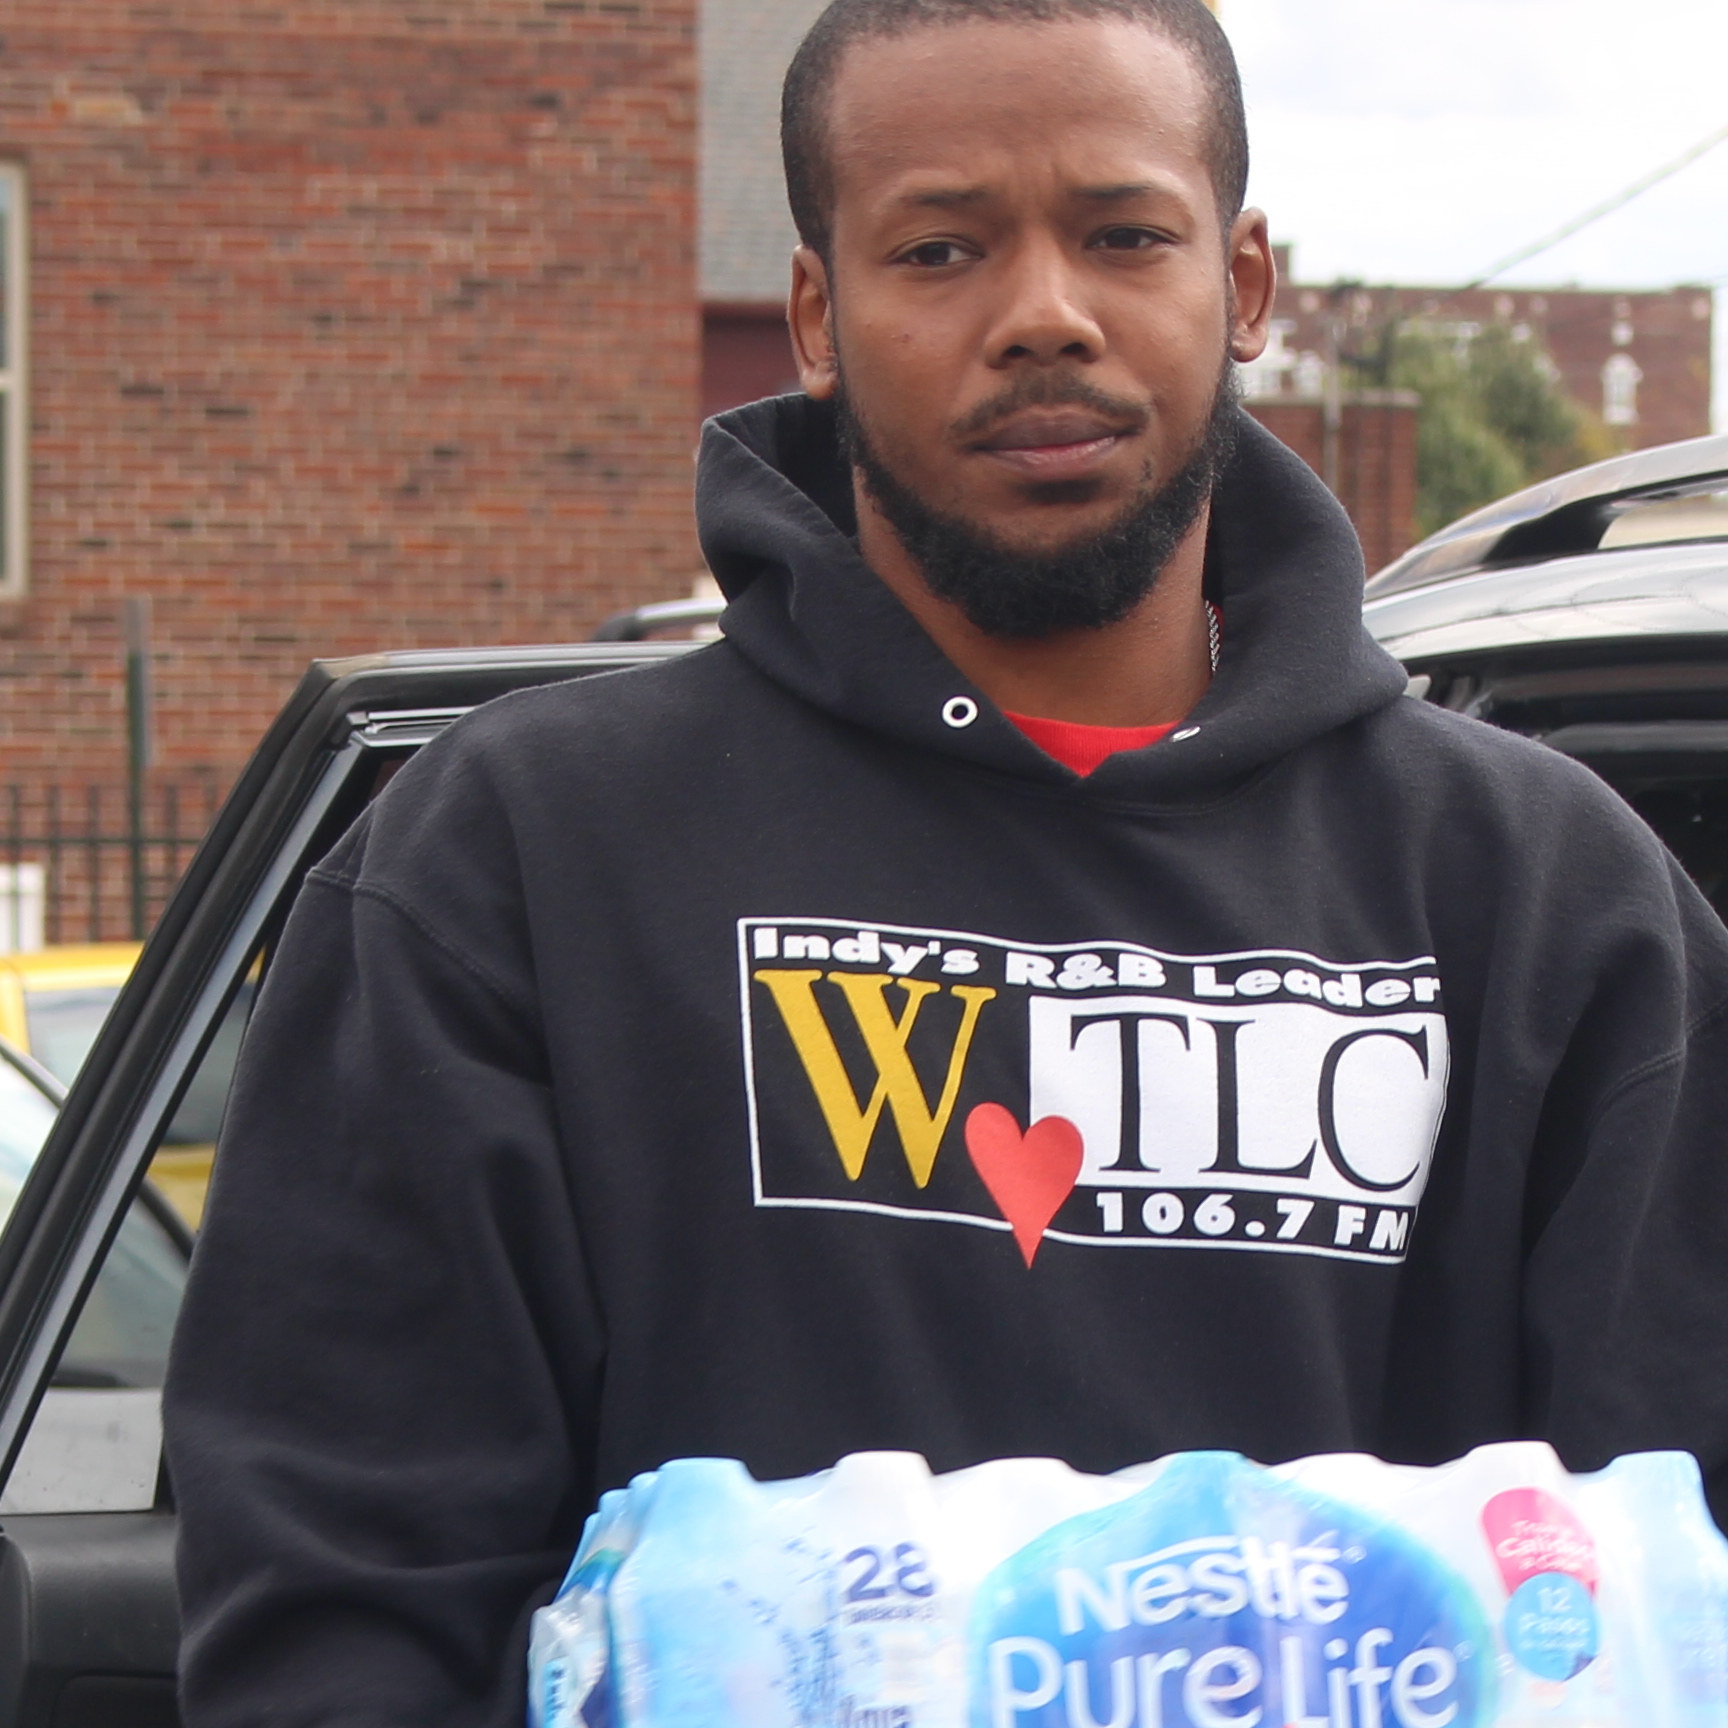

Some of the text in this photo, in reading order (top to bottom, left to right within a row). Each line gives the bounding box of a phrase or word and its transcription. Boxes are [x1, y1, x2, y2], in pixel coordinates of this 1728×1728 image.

[753, 926, 1441, 1009] Indy's R&B Leader
[753, 968, 1430, 1191] W TLC
[1096, 1192, 1409, 1252] 106.7 FM
[844, 1541, 935, 1602] 28
[1056, 1533, 1351, 1638] Nestlé
[1537, 1587, 1572, 1614] 12
